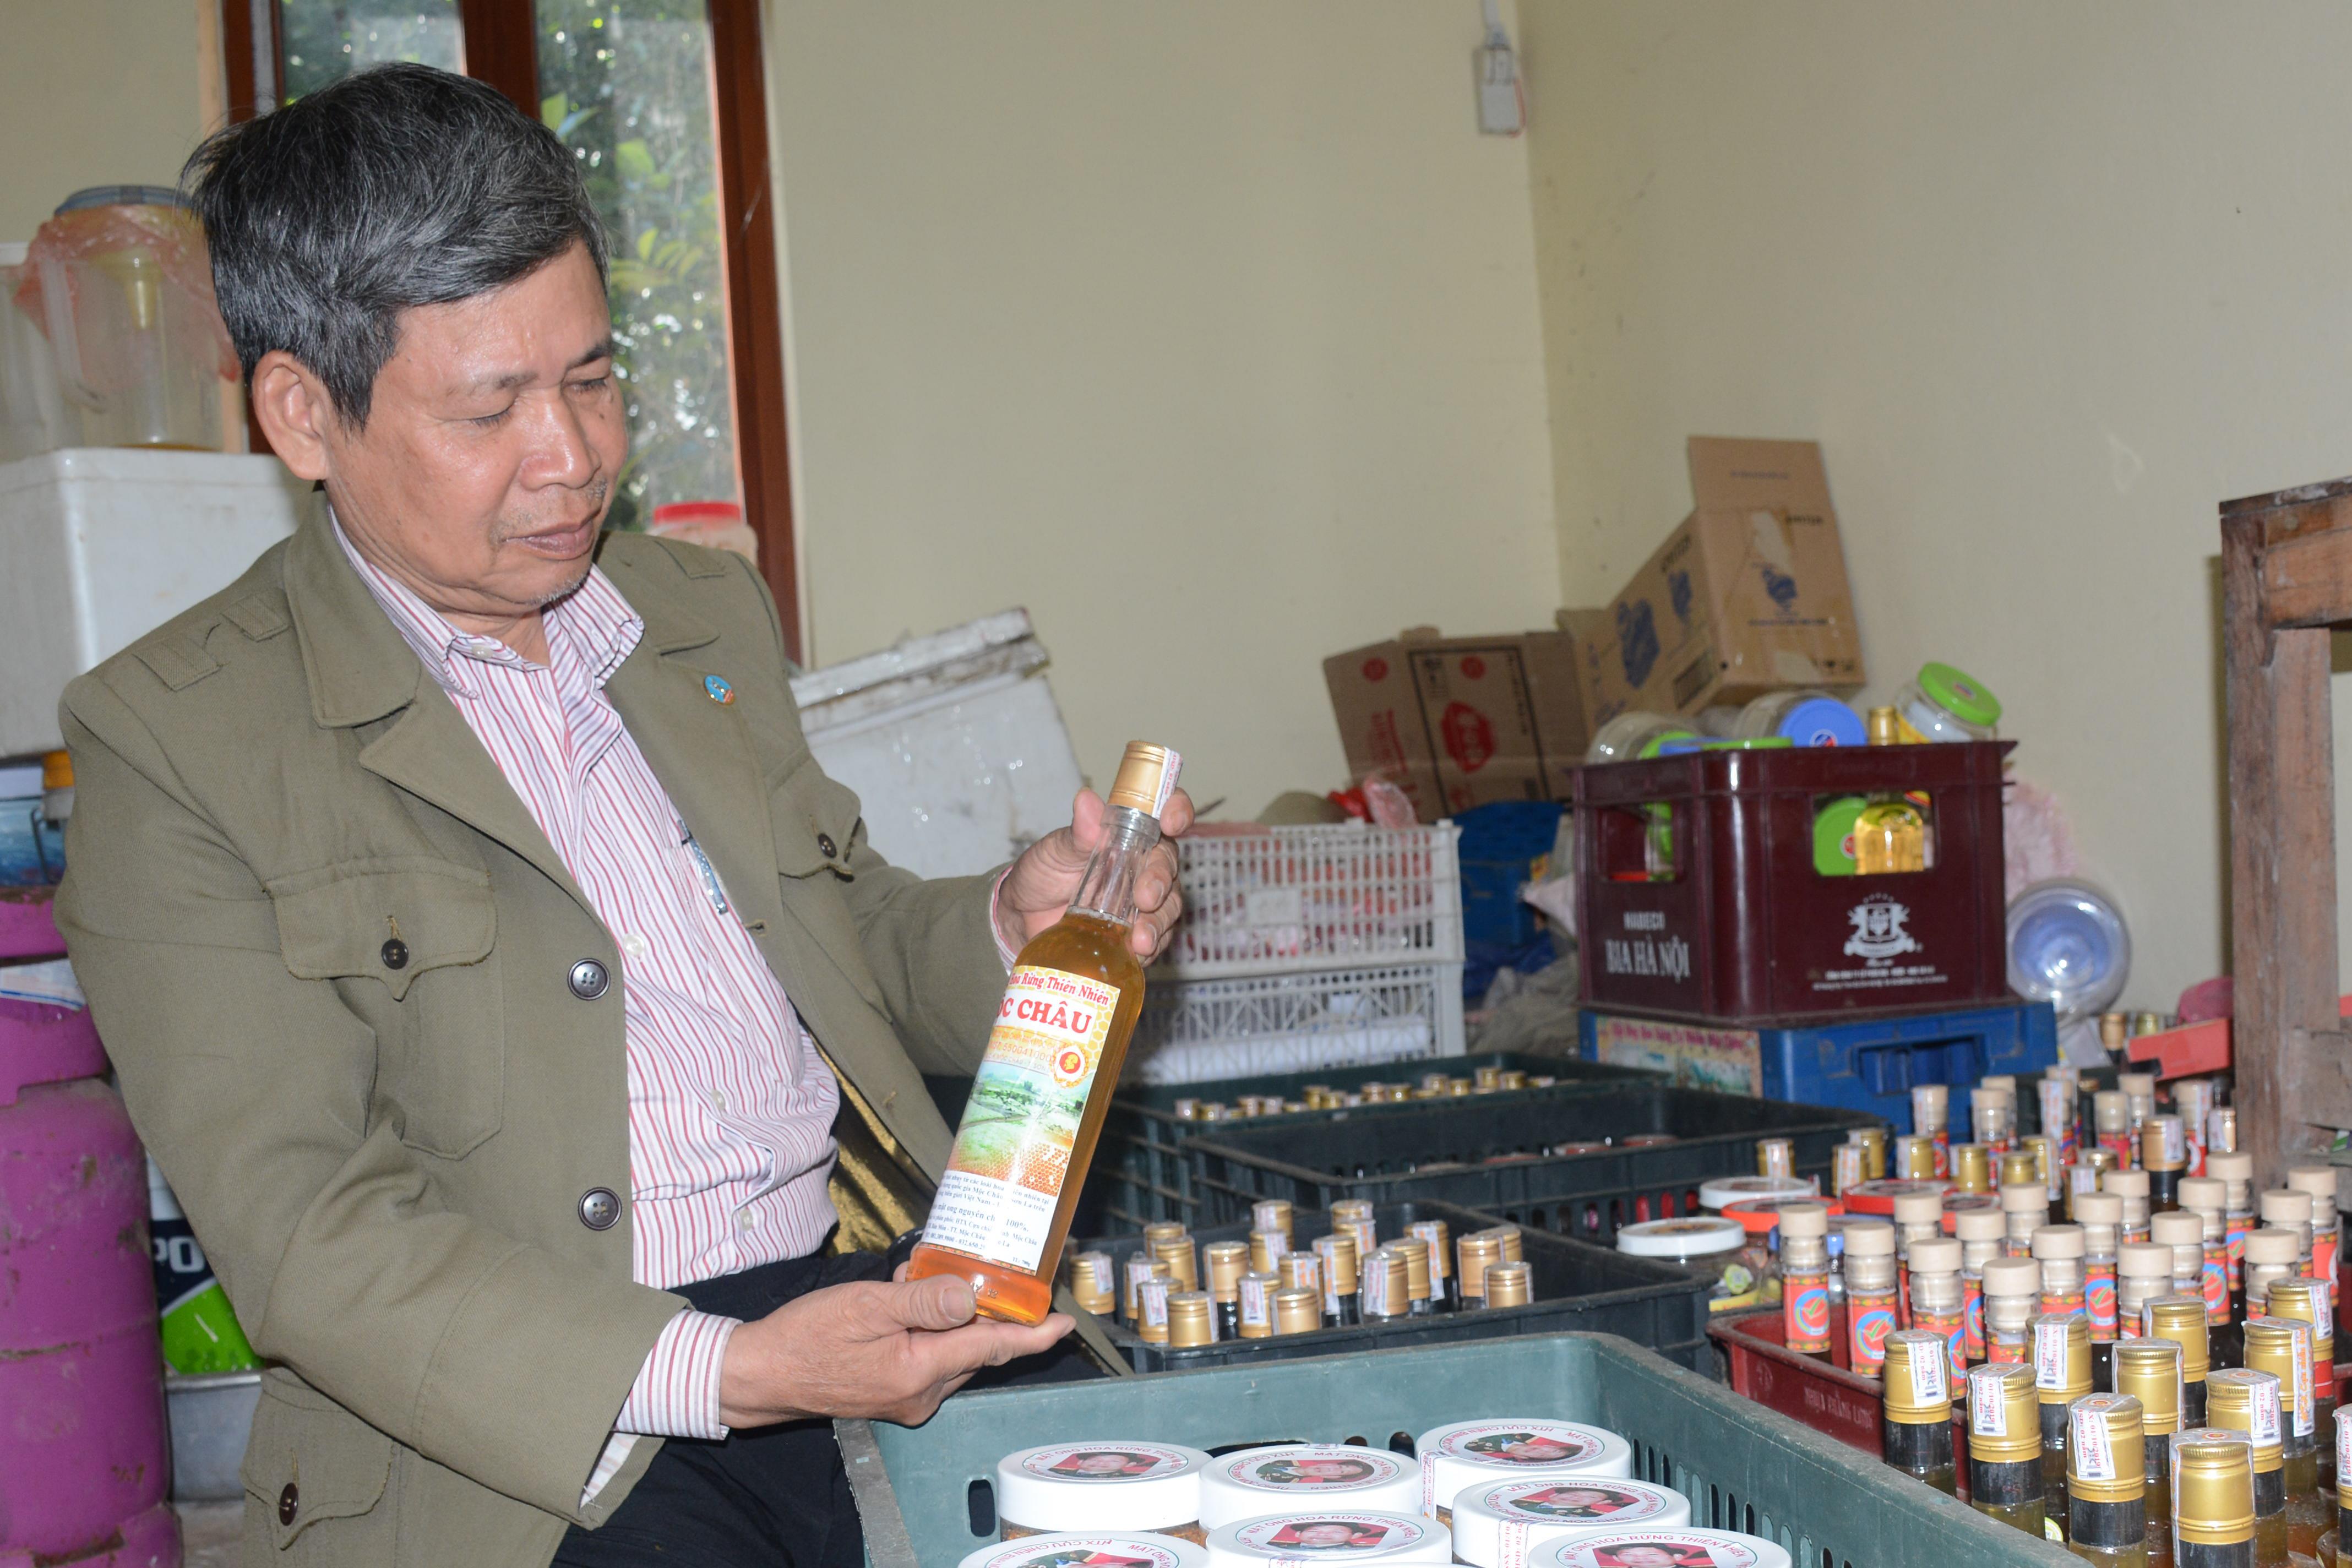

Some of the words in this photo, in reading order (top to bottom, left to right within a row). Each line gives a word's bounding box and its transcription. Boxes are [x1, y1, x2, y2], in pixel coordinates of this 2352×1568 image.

[1021, 972, 1044, 989] Rừng
[1047, 976, 1076, 994] Thiên
[1078, 985, 1109, 1005] Nhiên
[1017, 999, 1092, 1033] CHÂU
[977, 1196, 990, 1205] Nam
[959, 1207, 984, 1219] nguyên
[2081, 1430, 2086, 1438] 02
[2090, 1425, 2101, 1467] 01/10/2019
[1602, 1484, 1638, 1493] RỪNG
[1376, 1518, 1407, 1529] THIÊN
[1013, 1545, 1049, 1556] CHIẾN
[1571, 1542, 1595, 1551] ONG
[1681, 1536, 1721, 1547] THIÊN
[1718, 1543, 1747, 1558] NHIÊN
[1128, 1544, 1156, 1553] MẬT
[1152, 1551, 1169, 1563] ONG
